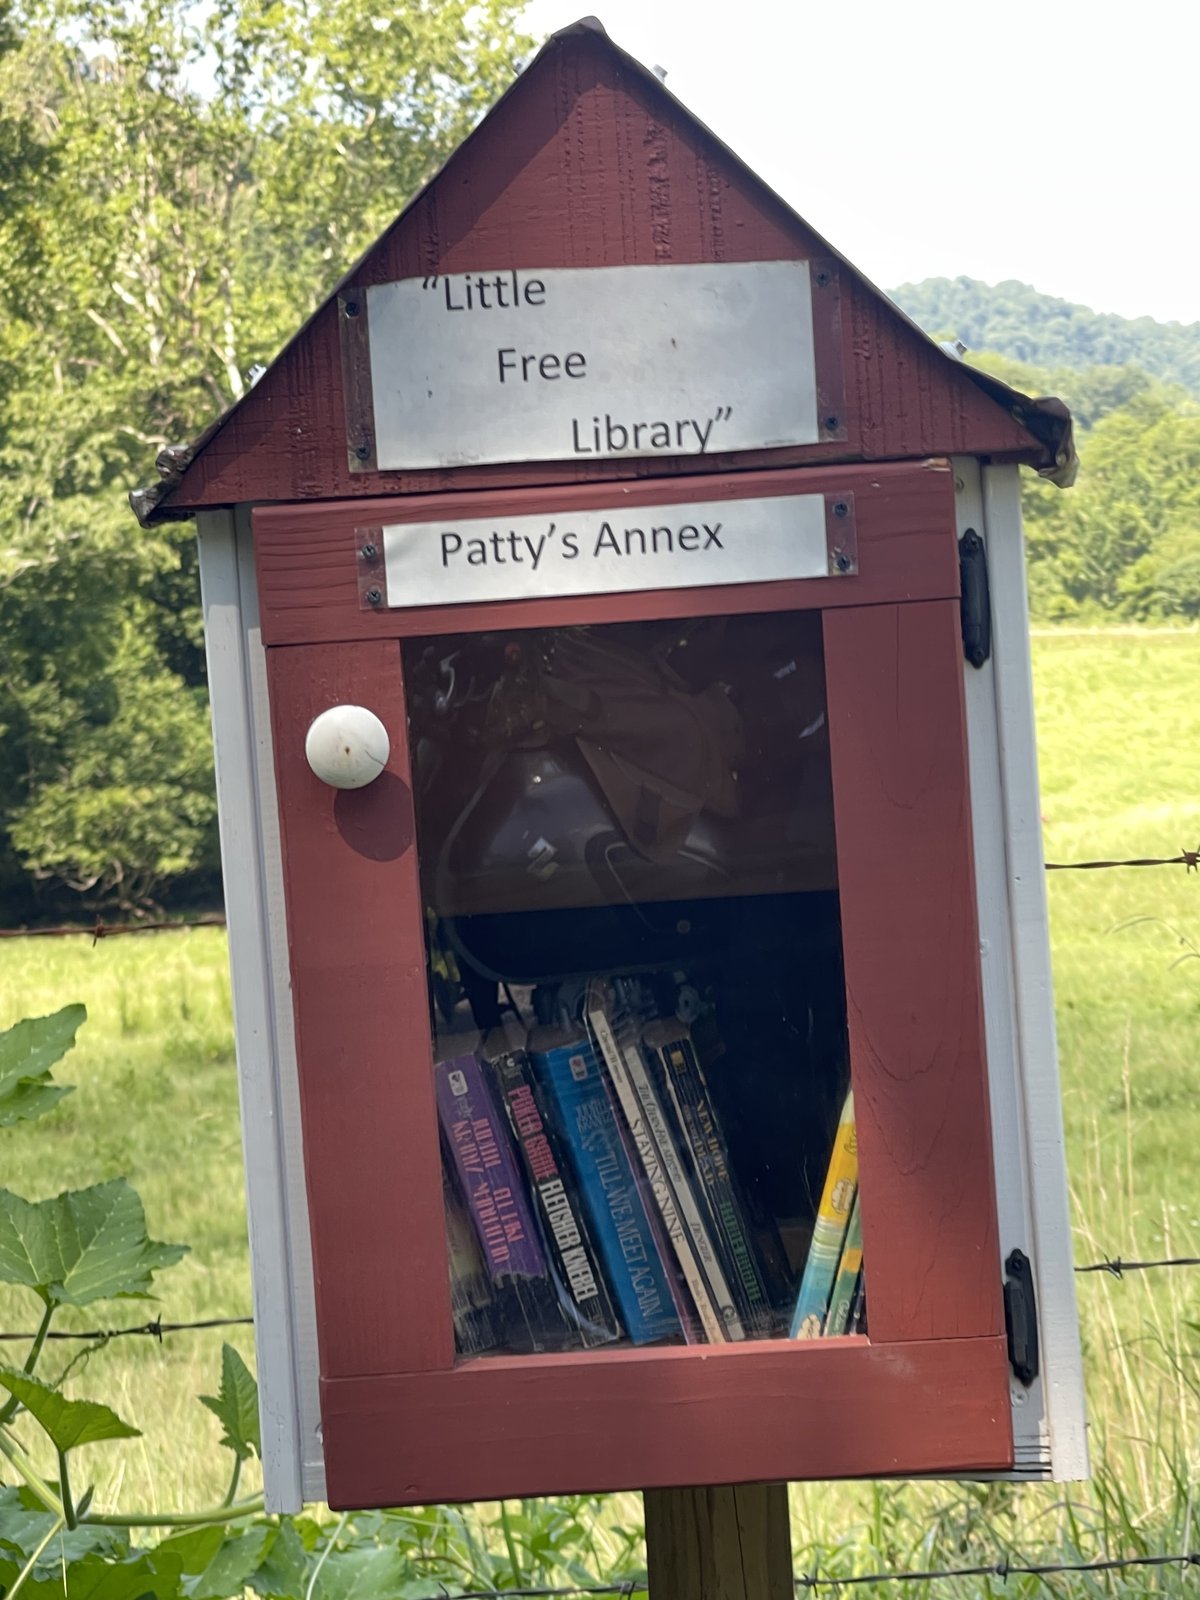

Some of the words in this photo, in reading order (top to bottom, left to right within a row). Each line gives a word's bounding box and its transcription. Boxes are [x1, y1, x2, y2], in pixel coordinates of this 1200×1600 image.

[421, 270, 546, 311] "Little
[497, 348, 587, 384] Free
[573, 406, 733, 453] Library"
[440, 523, 580, 569] Patty's
[593, 521, 724, 557] Annex
[508, 1084, 543, 1136] POKER
[596, 1152, 622, 1189] TILL
[632, 1118, 667, 1197] STAYING
[659, 1196, 685, 1244] NINE
[607, 1190, 633, 1219] WE
[539, 1178, 581, 1250] FLETCHER
[561, 1246, 598, 1304] KNEBEL
[615, 1218, 648, 1264] MEET
[628, 1263, 664, 1318] AGAIN
